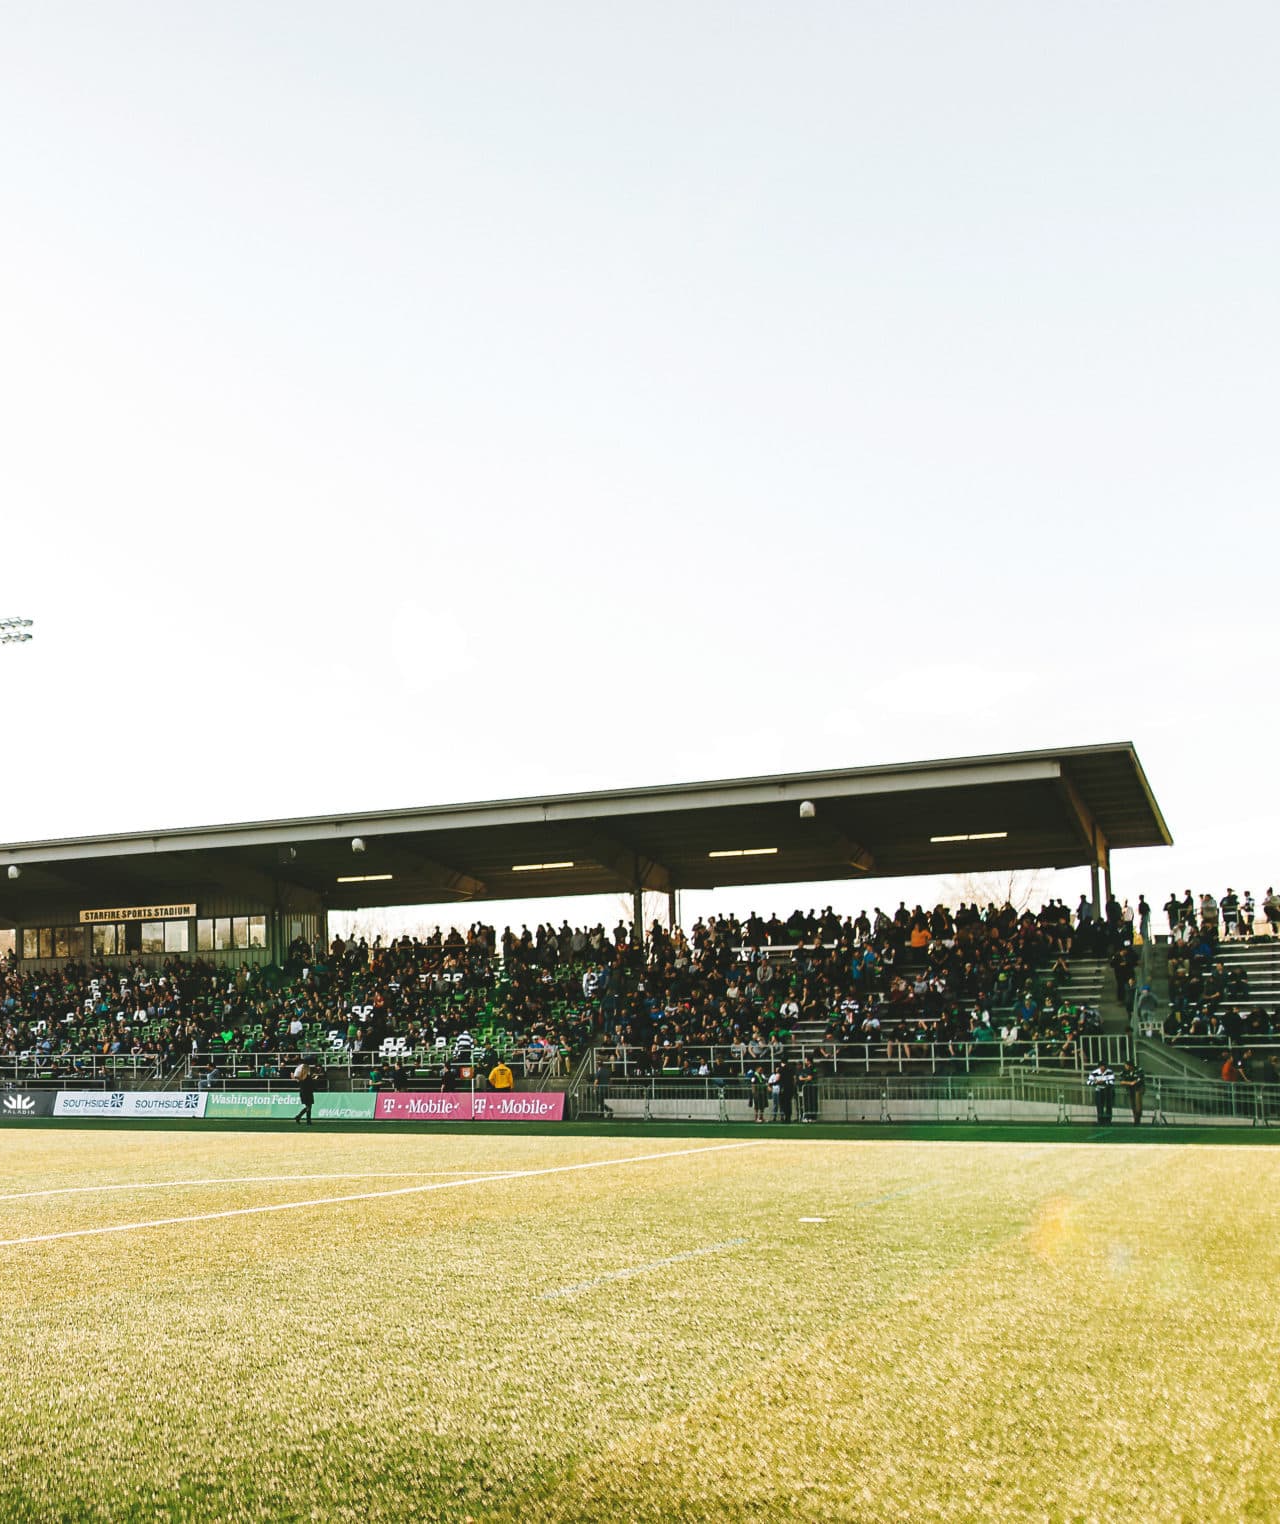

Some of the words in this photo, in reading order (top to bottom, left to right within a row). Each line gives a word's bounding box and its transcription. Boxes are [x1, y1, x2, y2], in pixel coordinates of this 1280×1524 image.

[84, 910, 120, 920] STARFIRE
[121, 908, 152, 919] SPORTS
[154, 906, 190, 917] STADIUM
[63, 1099, 110, 1108] SOUTHSIDE
[135, 1099, 184, 1109] SOUTHSIDE
[211, 1094, 271, 1106] Washington
[272, 1094, 302, 1105] Feder
